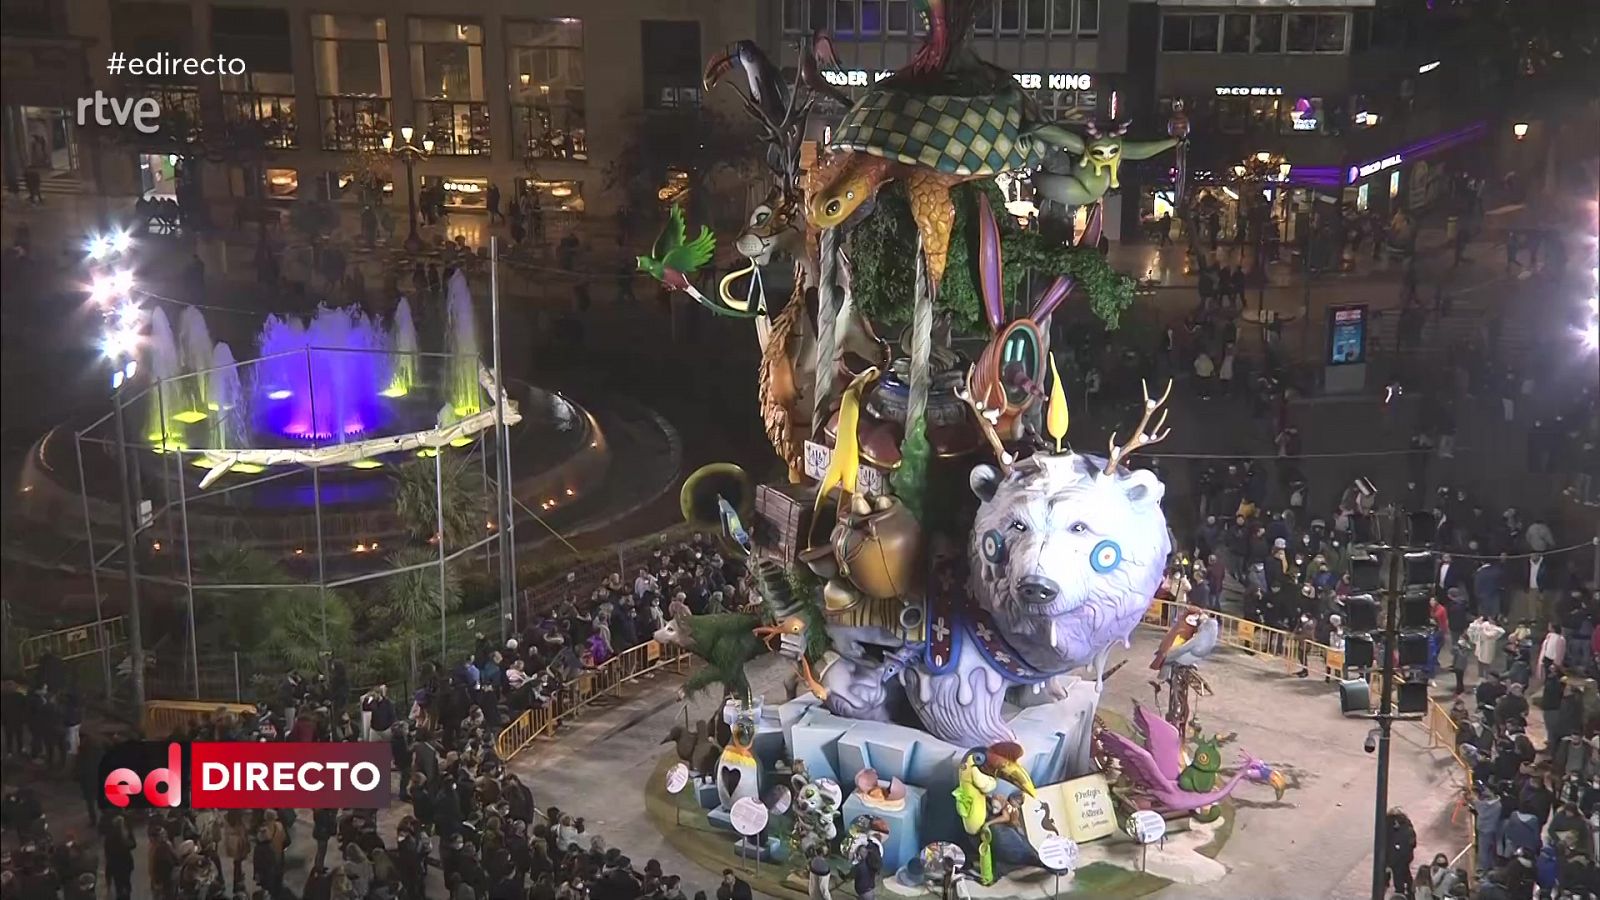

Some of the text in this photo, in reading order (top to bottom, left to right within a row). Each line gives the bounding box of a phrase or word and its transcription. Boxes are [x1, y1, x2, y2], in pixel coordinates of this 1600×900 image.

[1048, 74, 1091, 90] KING
[1215, 87, 1284, 96] TACO BELL
